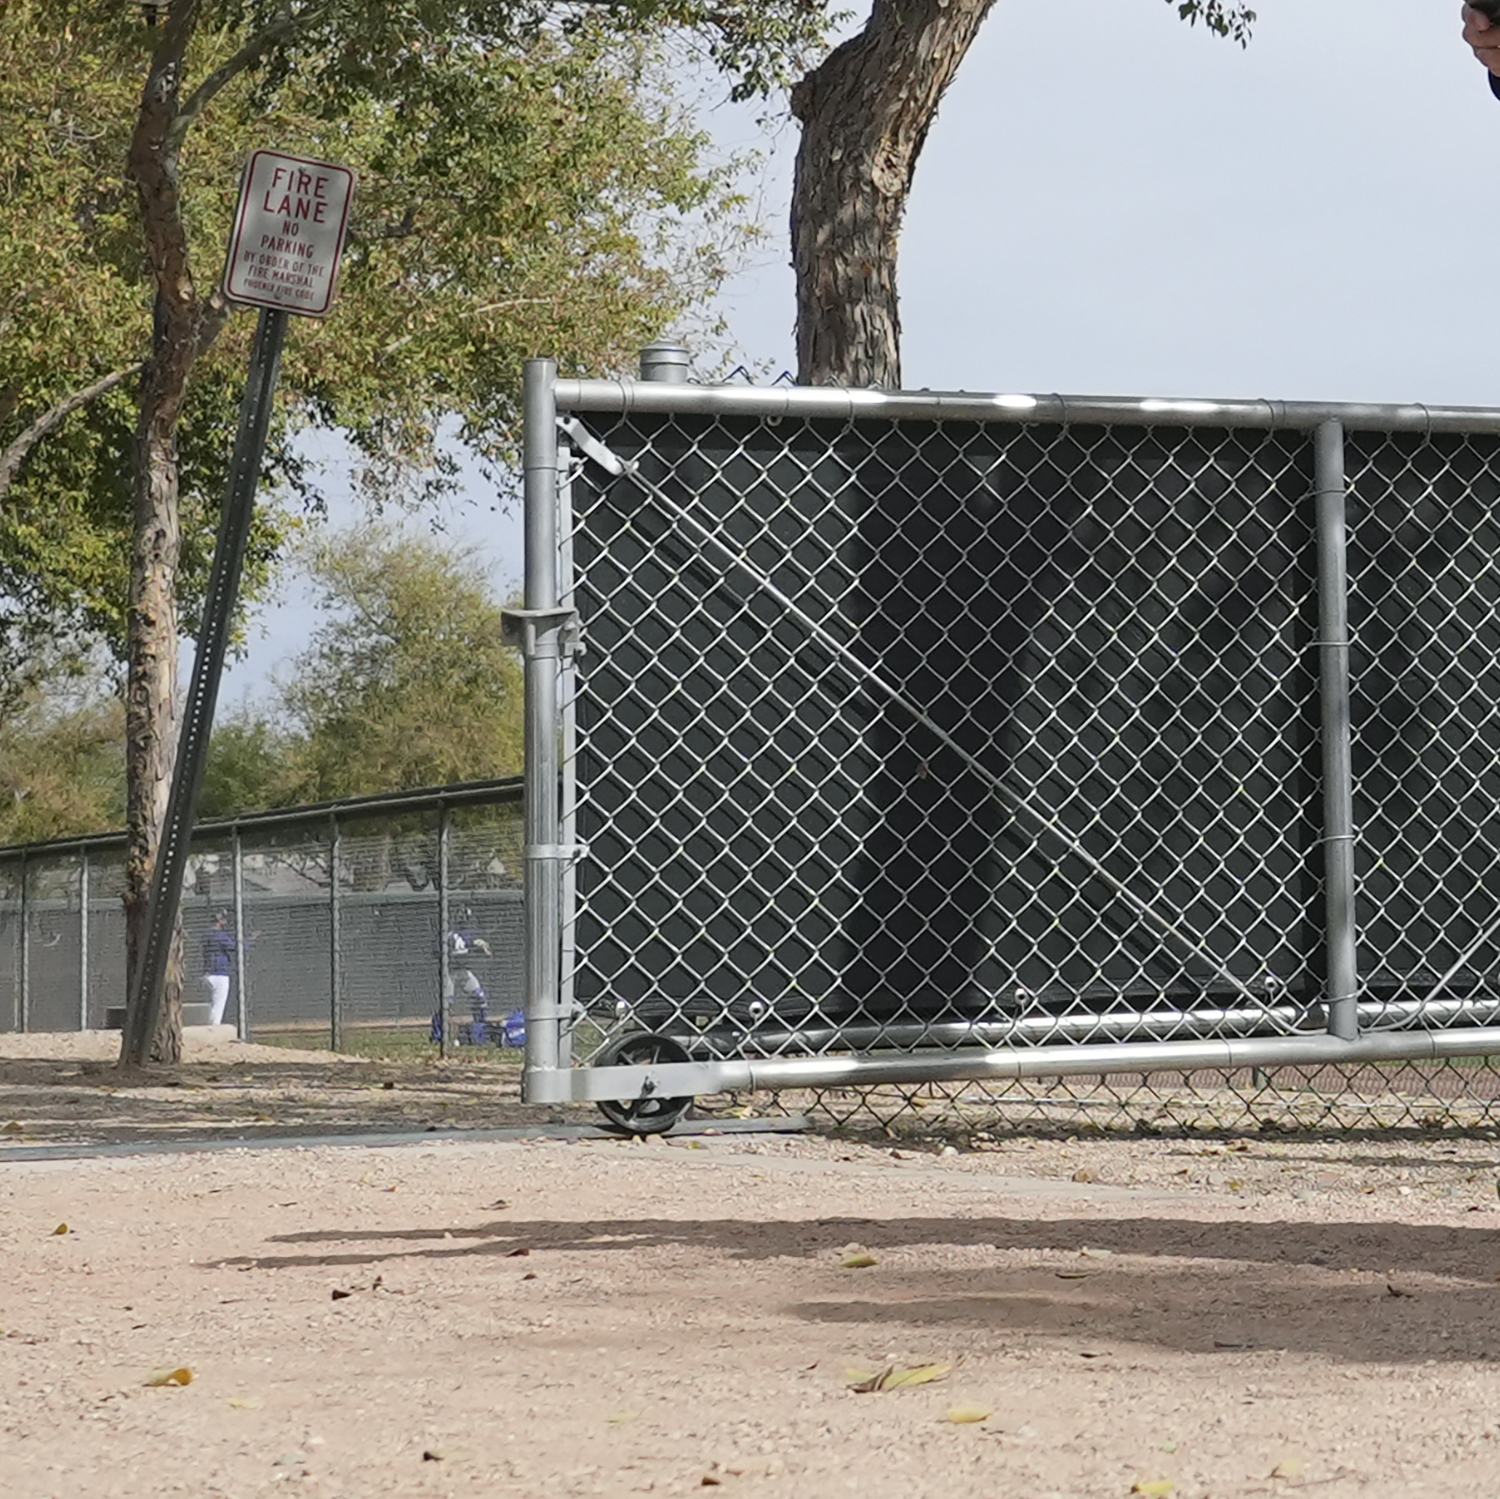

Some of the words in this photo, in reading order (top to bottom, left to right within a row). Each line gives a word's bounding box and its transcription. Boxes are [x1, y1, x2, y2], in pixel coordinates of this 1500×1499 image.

[272, 167, 329, 199] FIRE
[263, 190, 328, 223] LANE
[282, 220, 300, 237] NO
[261, 234, 315, 259] PARKING
[248, 264, 269, 280] FIRE
[272, 269, 314, 288] MARSHAL
[259, 253, 289, 270] ORDER
[292, 261, 305, 273] OF
[307, 263, 326, 277] THE
